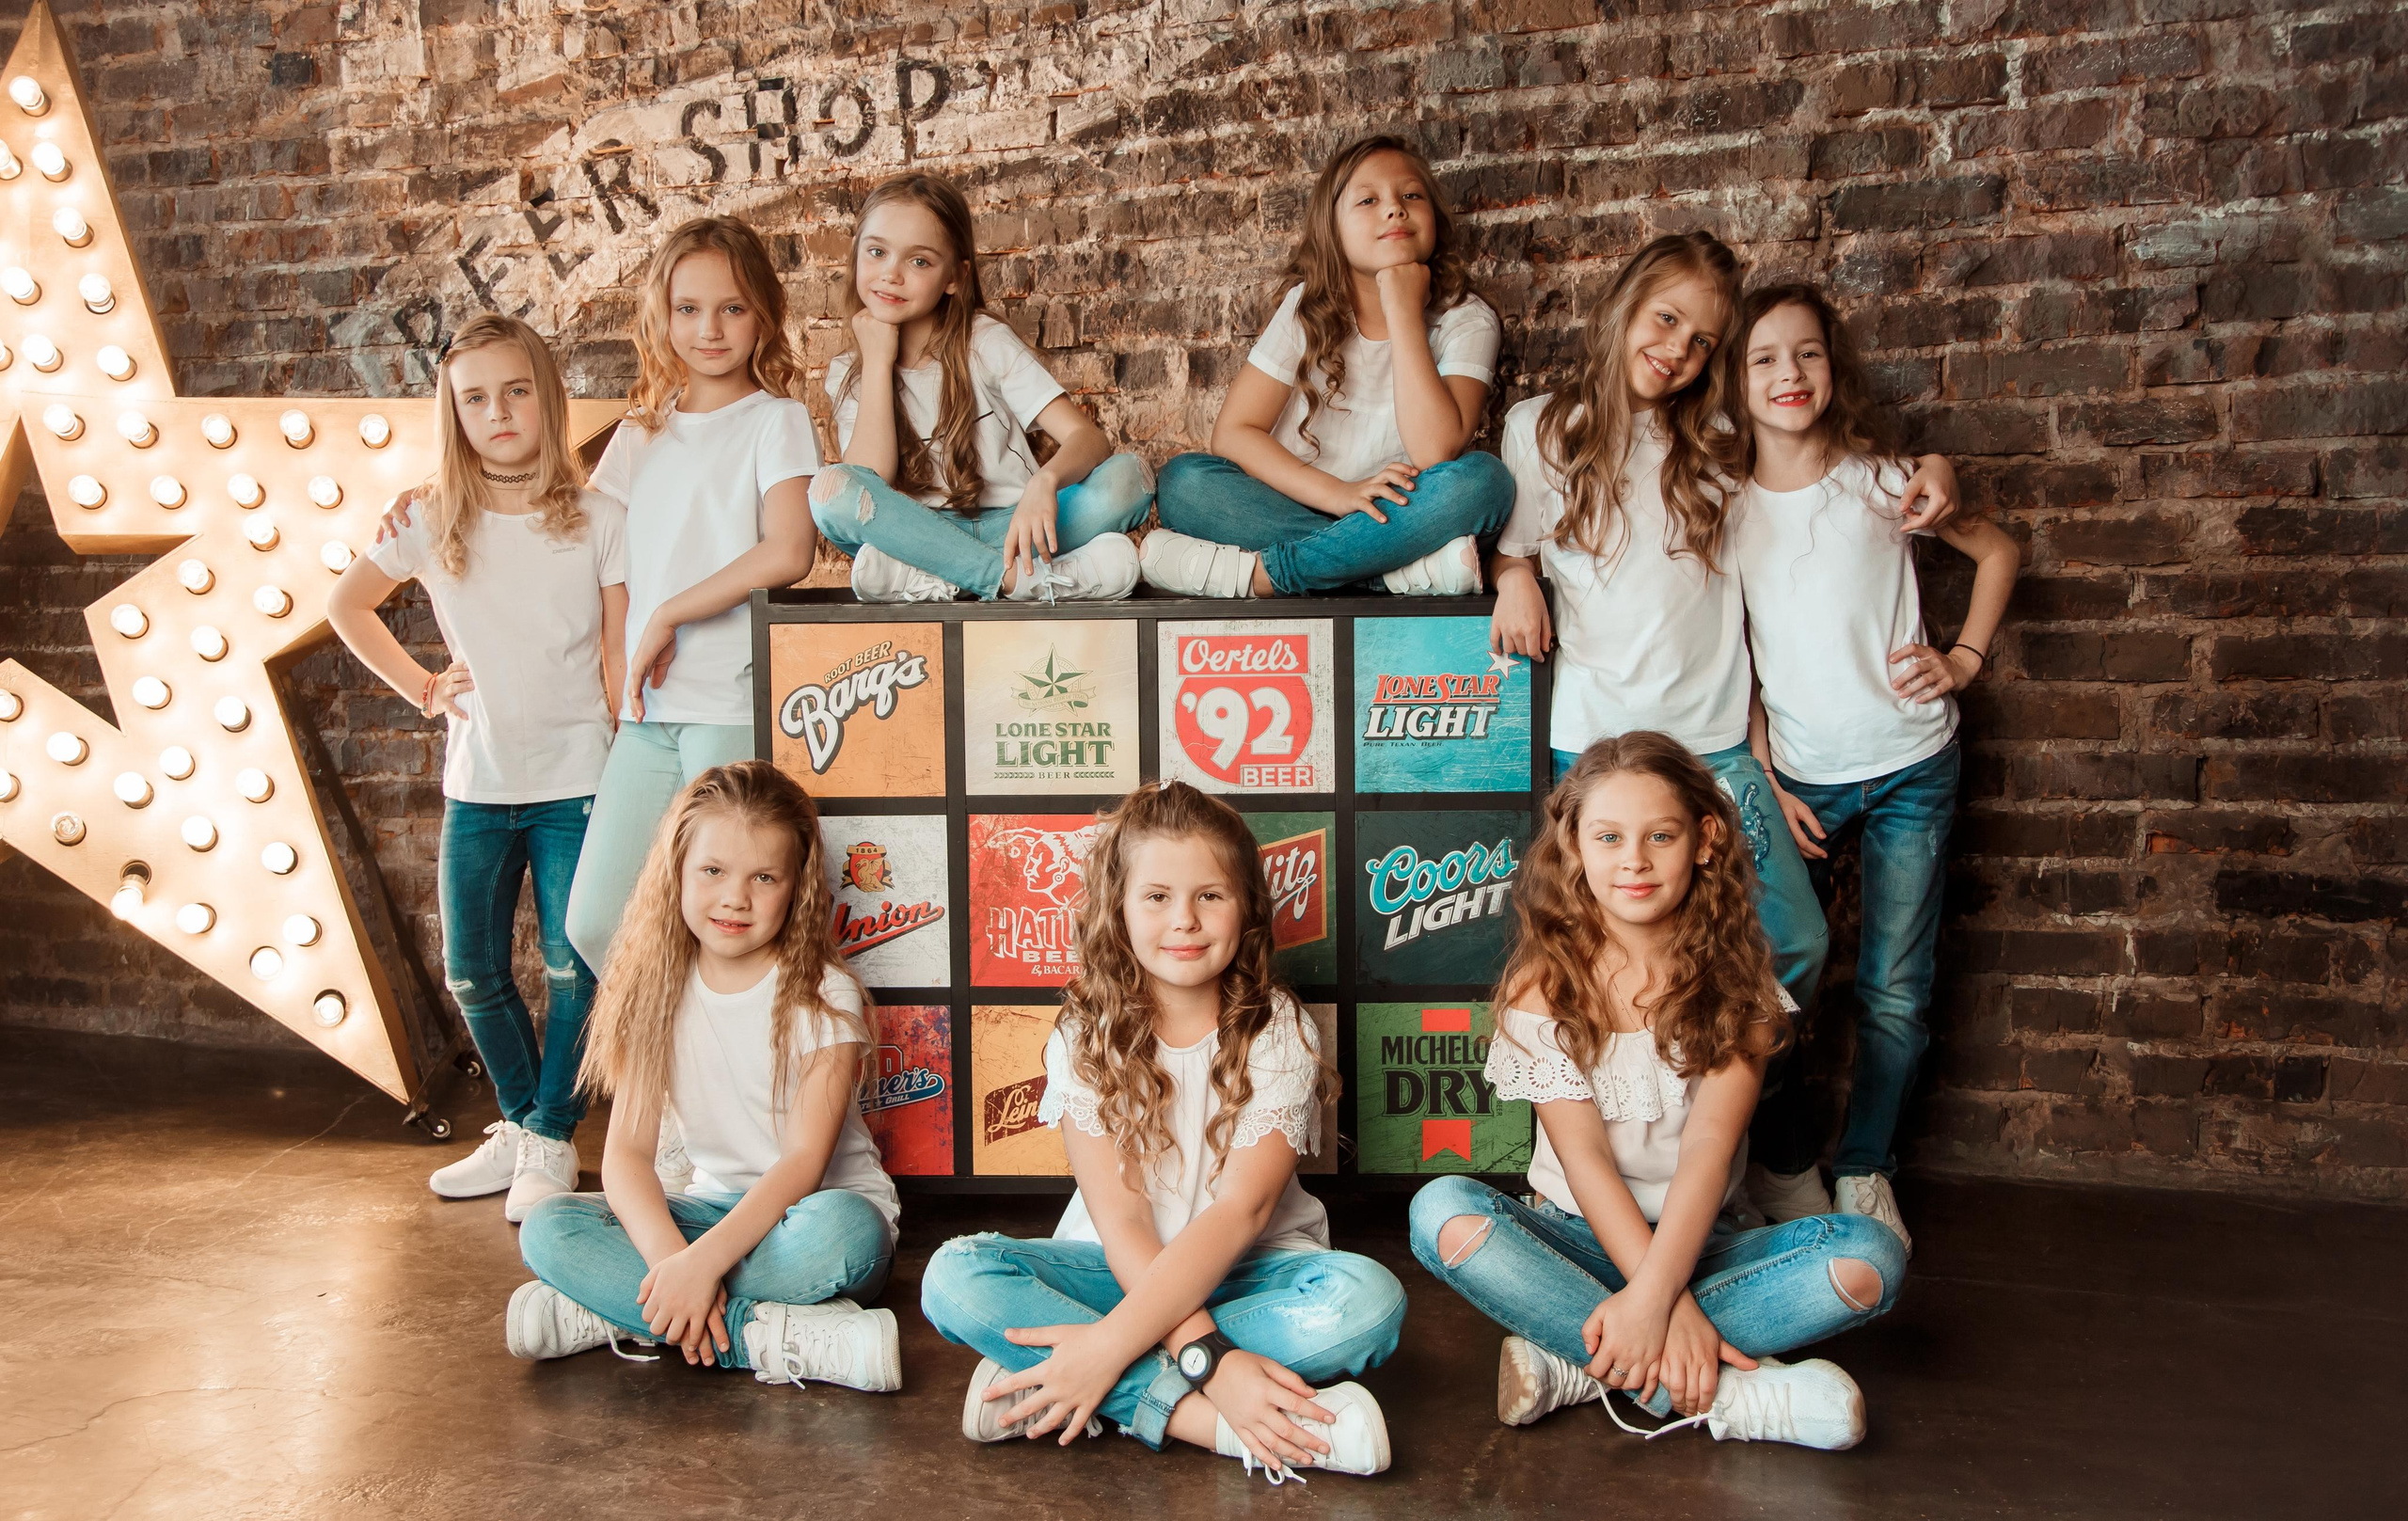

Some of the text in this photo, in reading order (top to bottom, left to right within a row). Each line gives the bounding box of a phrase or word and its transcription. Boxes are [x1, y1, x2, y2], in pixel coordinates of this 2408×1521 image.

[680, 59, 951, 182] SHOP
[823, 641, 893, 684] ROOT BEER
[1181, 638, 1300, 673] Oertels
[780, 650, 929, 774] Barq's
[1057, 721, 1112, 737] STAR
[1181, 687, 1293, 771] '92
[1363, 705, 1499, 740] LIGHT
[994, 739, 1116, 768] LIGHT
[1038, 771, 1072, 780] BEER
[1243, 767, 1313, 787] BEER
[1365, 836, 1519, 915] Coors
[1384, 880, 1513, 952] LIGHT
[885, 1094, 910, 1105] GRILL
[1383, 1068, 1497, 1117] DRY
